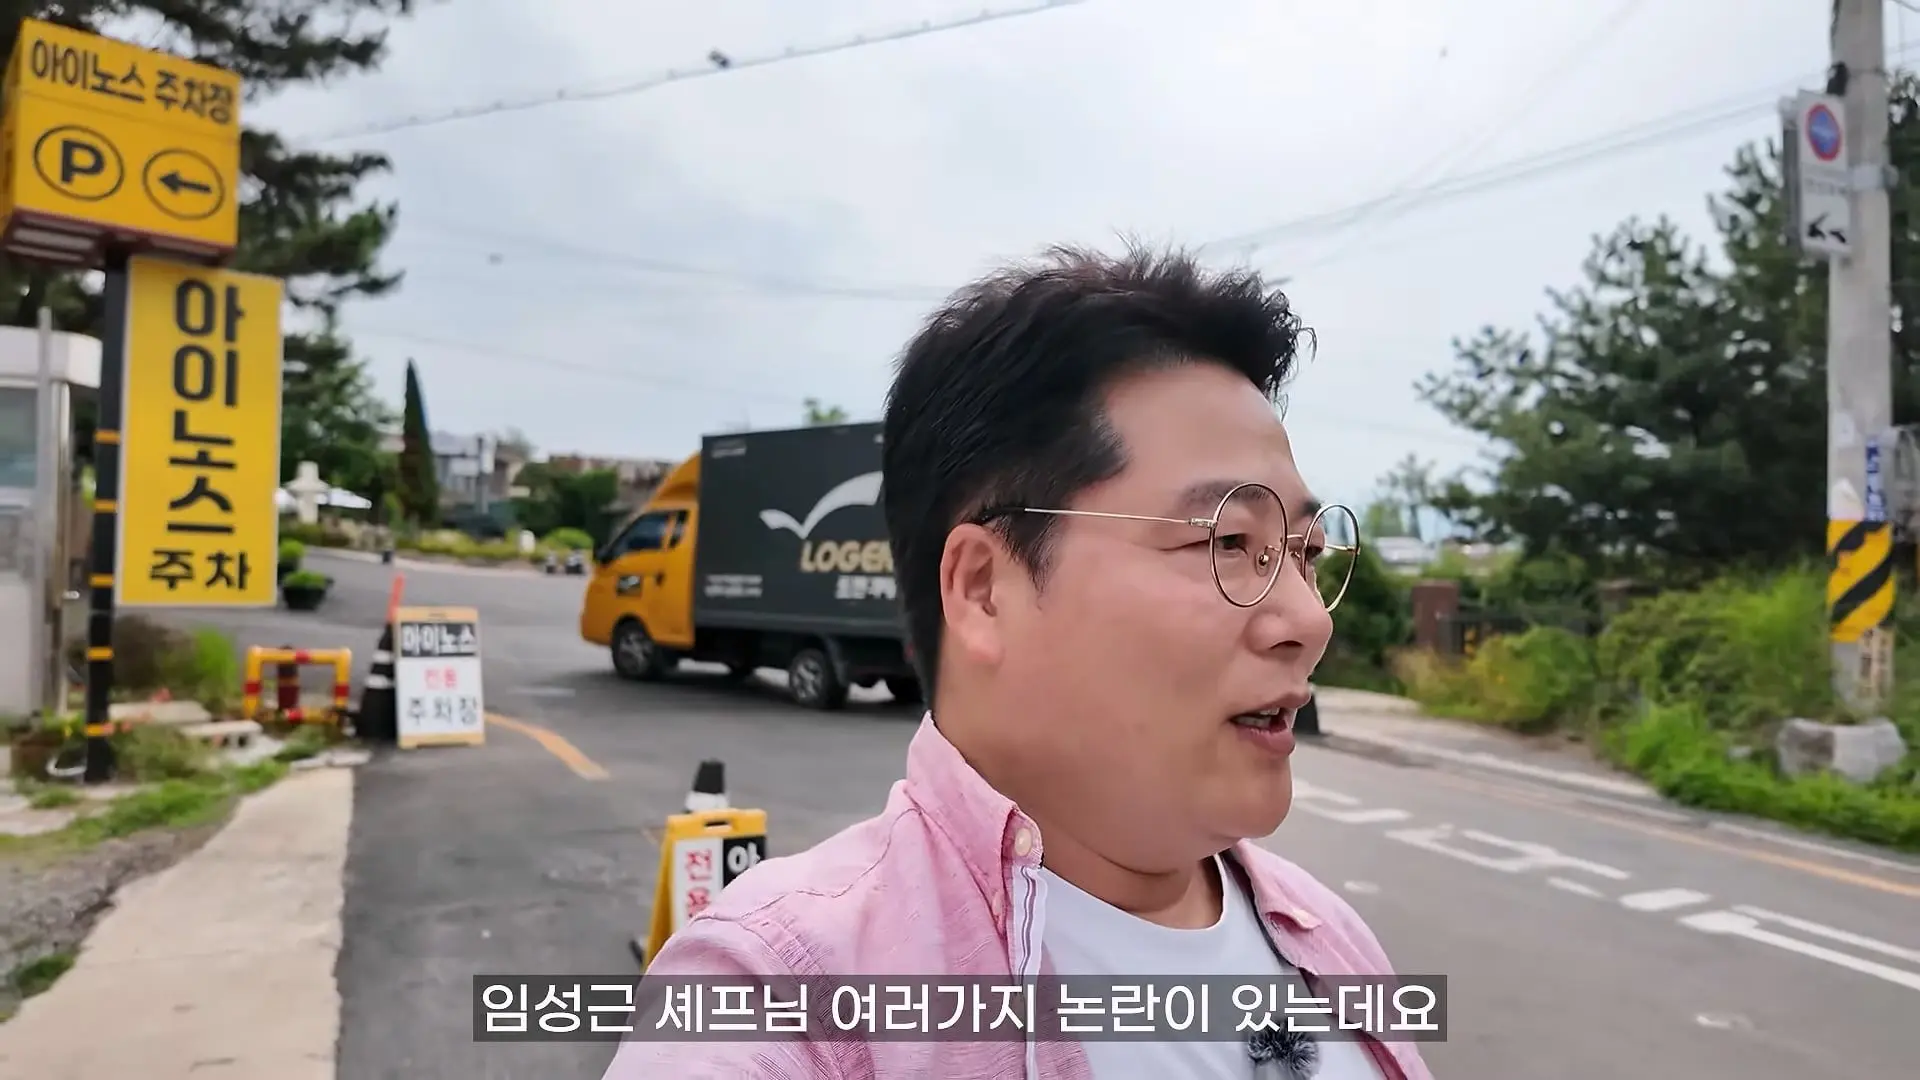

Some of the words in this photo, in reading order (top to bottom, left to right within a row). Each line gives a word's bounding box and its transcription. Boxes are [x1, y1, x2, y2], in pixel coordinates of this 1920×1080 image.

[31, 39, 146, 103] 아이노스
[155, 69, 234, 125] 주차장
[61, 139, 105, 184] P
[167, 278, 245, 534] 아이노스
[149, 550, 252, 590] 주차
[402, 624, 476, 655] 아이노스
[408, 697, 478, 726] 주차장
